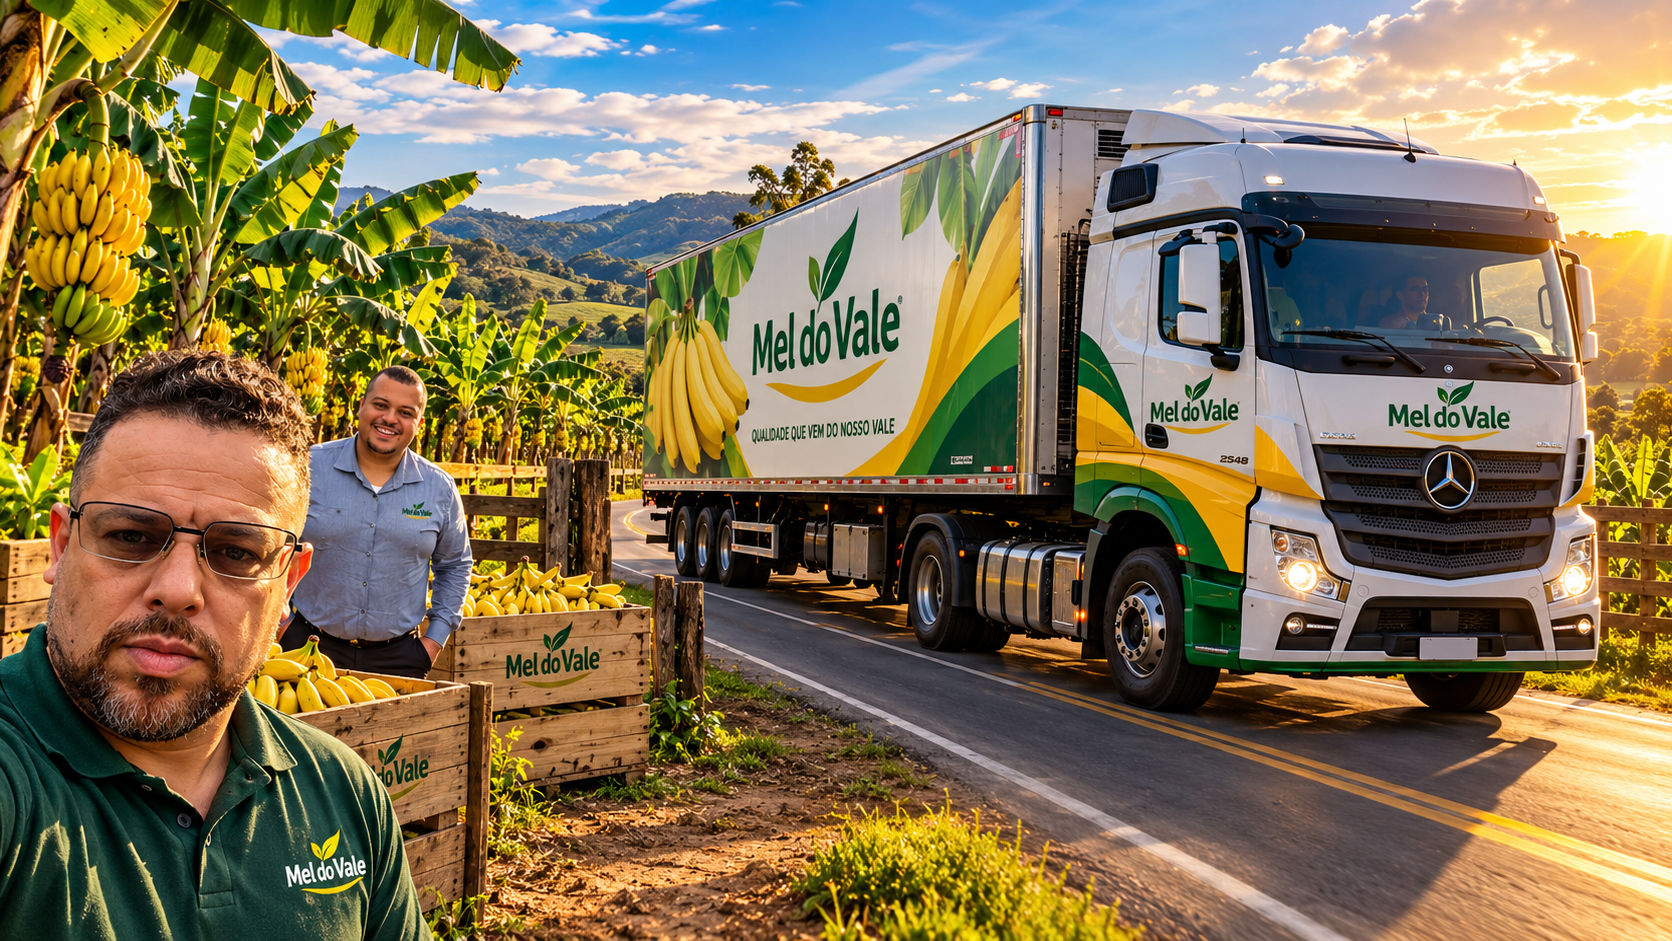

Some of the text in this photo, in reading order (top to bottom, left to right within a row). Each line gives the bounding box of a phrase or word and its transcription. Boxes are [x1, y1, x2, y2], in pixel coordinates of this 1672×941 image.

[752, 311, 795, 376] Mel
[800, 308, 831, 368] do
[1150, 398, 1239, 422] Mel do Vale
[1388, 403, 1510, 429] Mel do Vale
[752, 417, 895, 444] QUALIDADE QUE VEM DO NOSSO VALE
[506, 646, 600, 679] Mel do Vale
[393, 754, 429, 785] Vale
[285, 855, 366, 887] Mel do Vale
